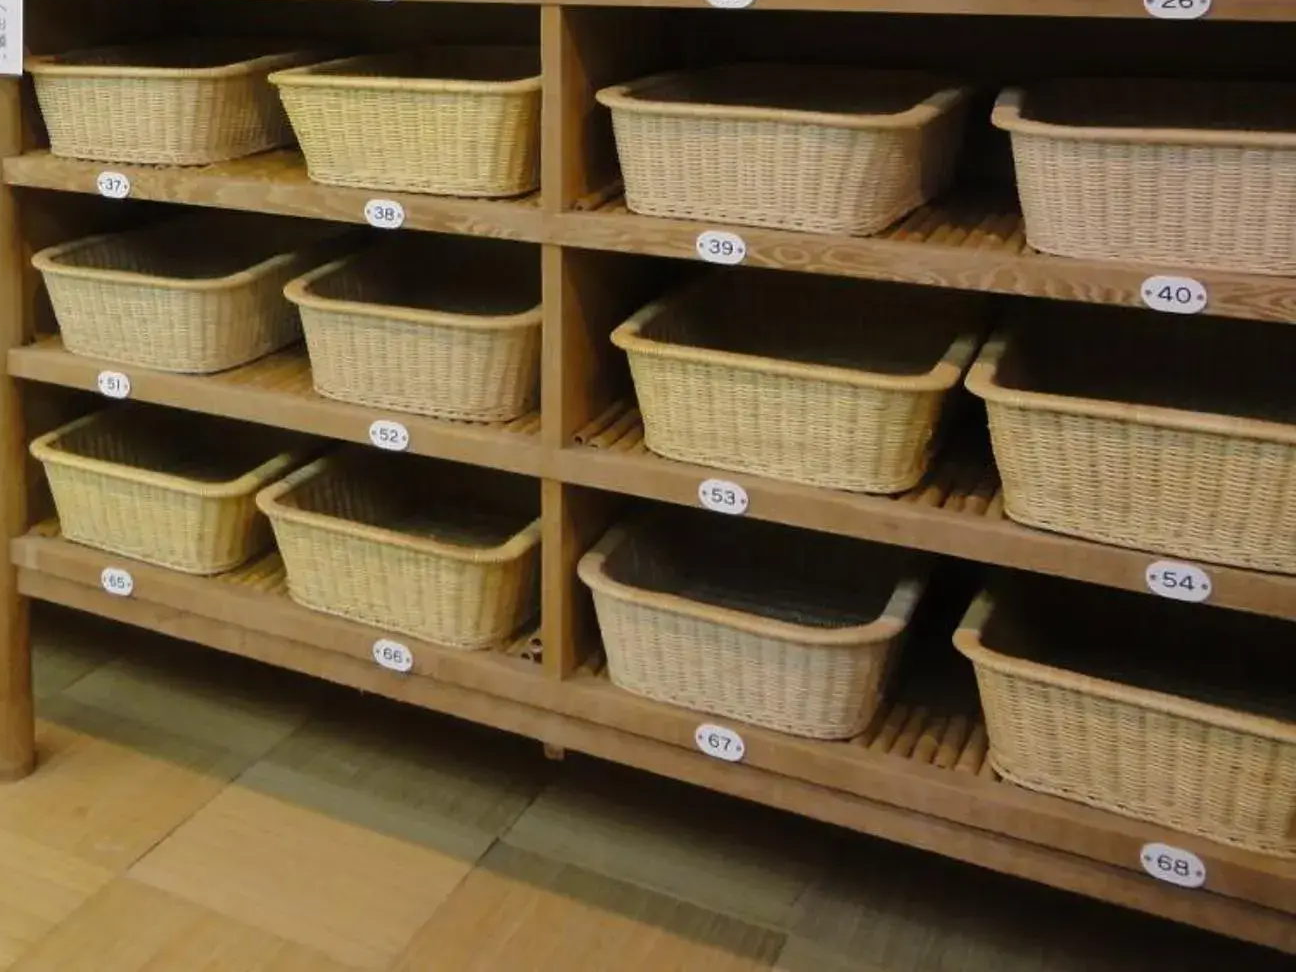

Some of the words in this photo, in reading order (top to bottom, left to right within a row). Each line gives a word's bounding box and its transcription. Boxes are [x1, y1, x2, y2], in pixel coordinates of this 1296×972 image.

[105, 178, 121, 193] 37
[374, 207, 395, 221] 38
[708, 239, 733, 255] 39
[1158, 286, 1191, 304] 40
[107, 378, 120, 391] 51
[379, 428, 398, 443] 52
[711, 488, 735, 506] 53
[109, 576, 125, 589] 65
[1162, 571, 1195, 590] 54
[383, 648, 402, 663] 66
[708, 733, 731, 751] 67
[1157, 855, 1189, 876] 68
